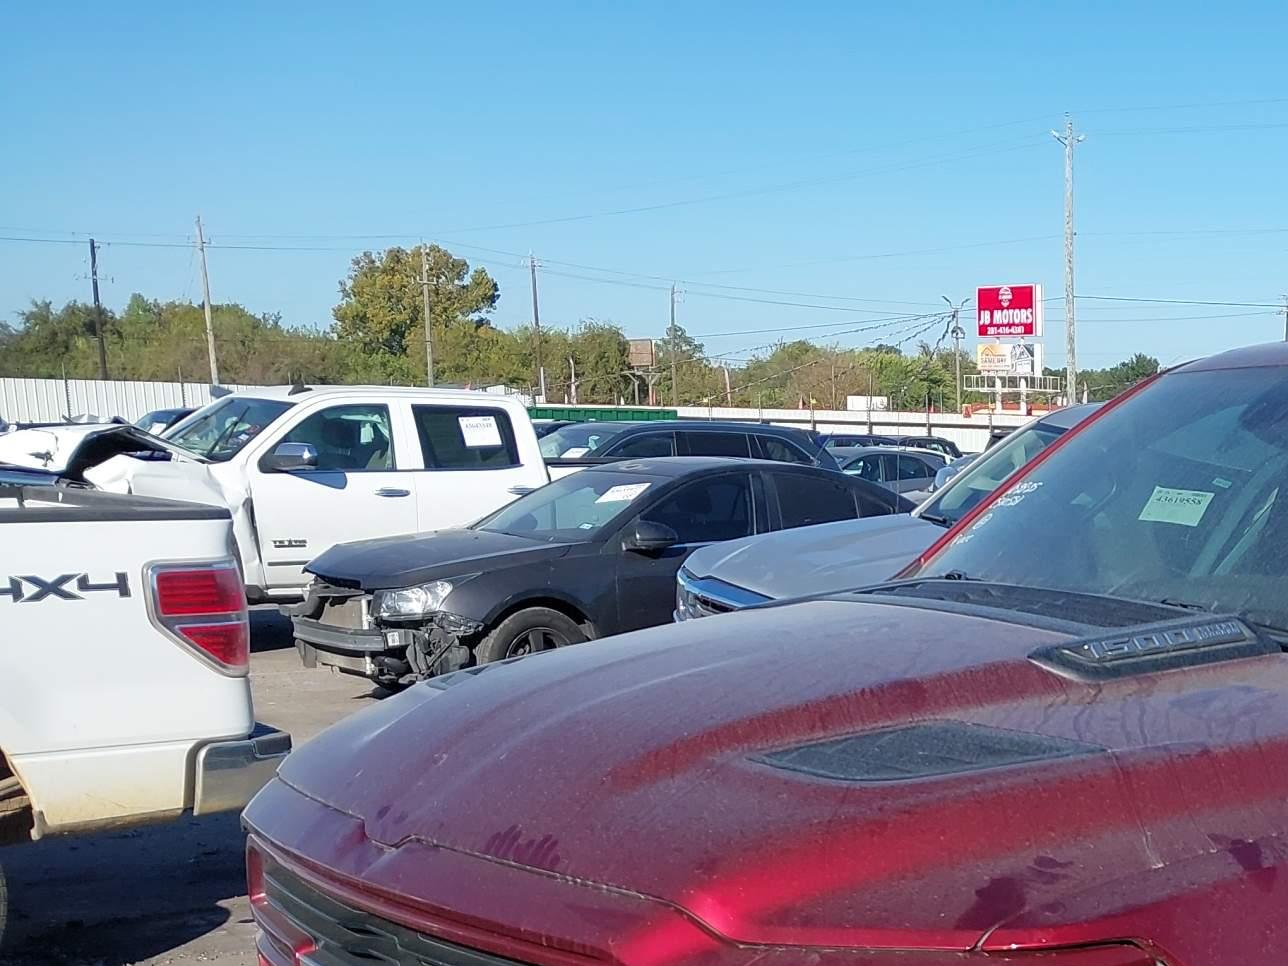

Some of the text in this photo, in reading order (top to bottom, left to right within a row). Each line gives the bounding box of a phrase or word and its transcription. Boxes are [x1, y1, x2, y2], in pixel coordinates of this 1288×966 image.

[979, 308, 1033, 325] JB MOTORS
[1089, 628, 1196, 658] 1500
